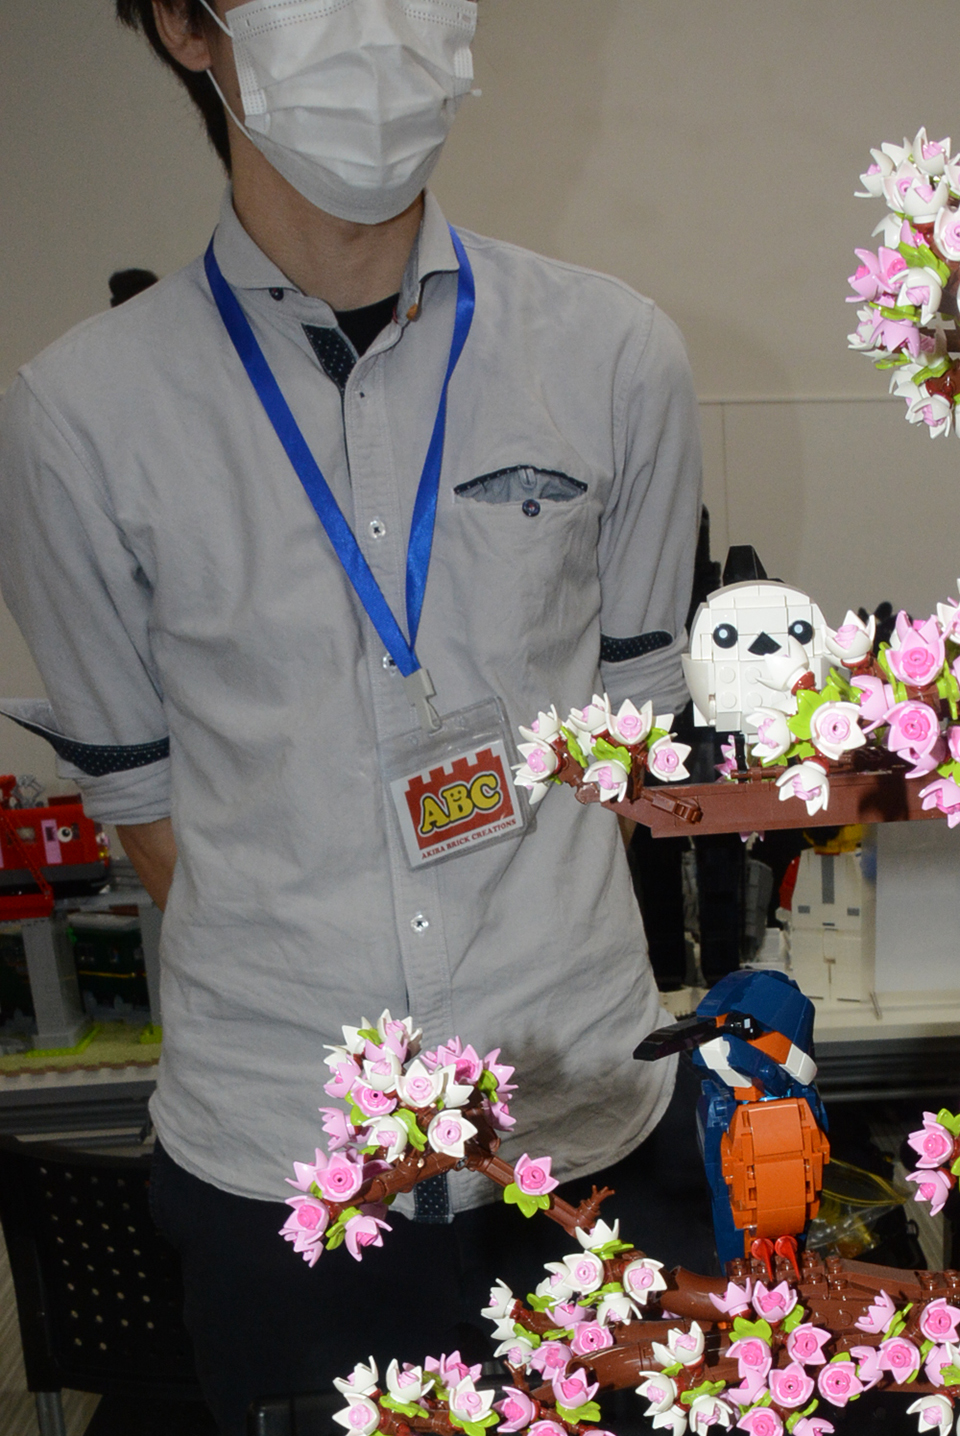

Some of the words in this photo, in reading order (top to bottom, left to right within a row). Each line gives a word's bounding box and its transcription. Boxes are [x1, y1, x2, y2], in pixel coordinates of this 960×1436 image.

[420, 773, 501, 835] ABC
[421, 846, 446, 860] AKIRA
[447, 836, 470, 850] BRICK
[471, 818, 517, 840] CREATIONS
